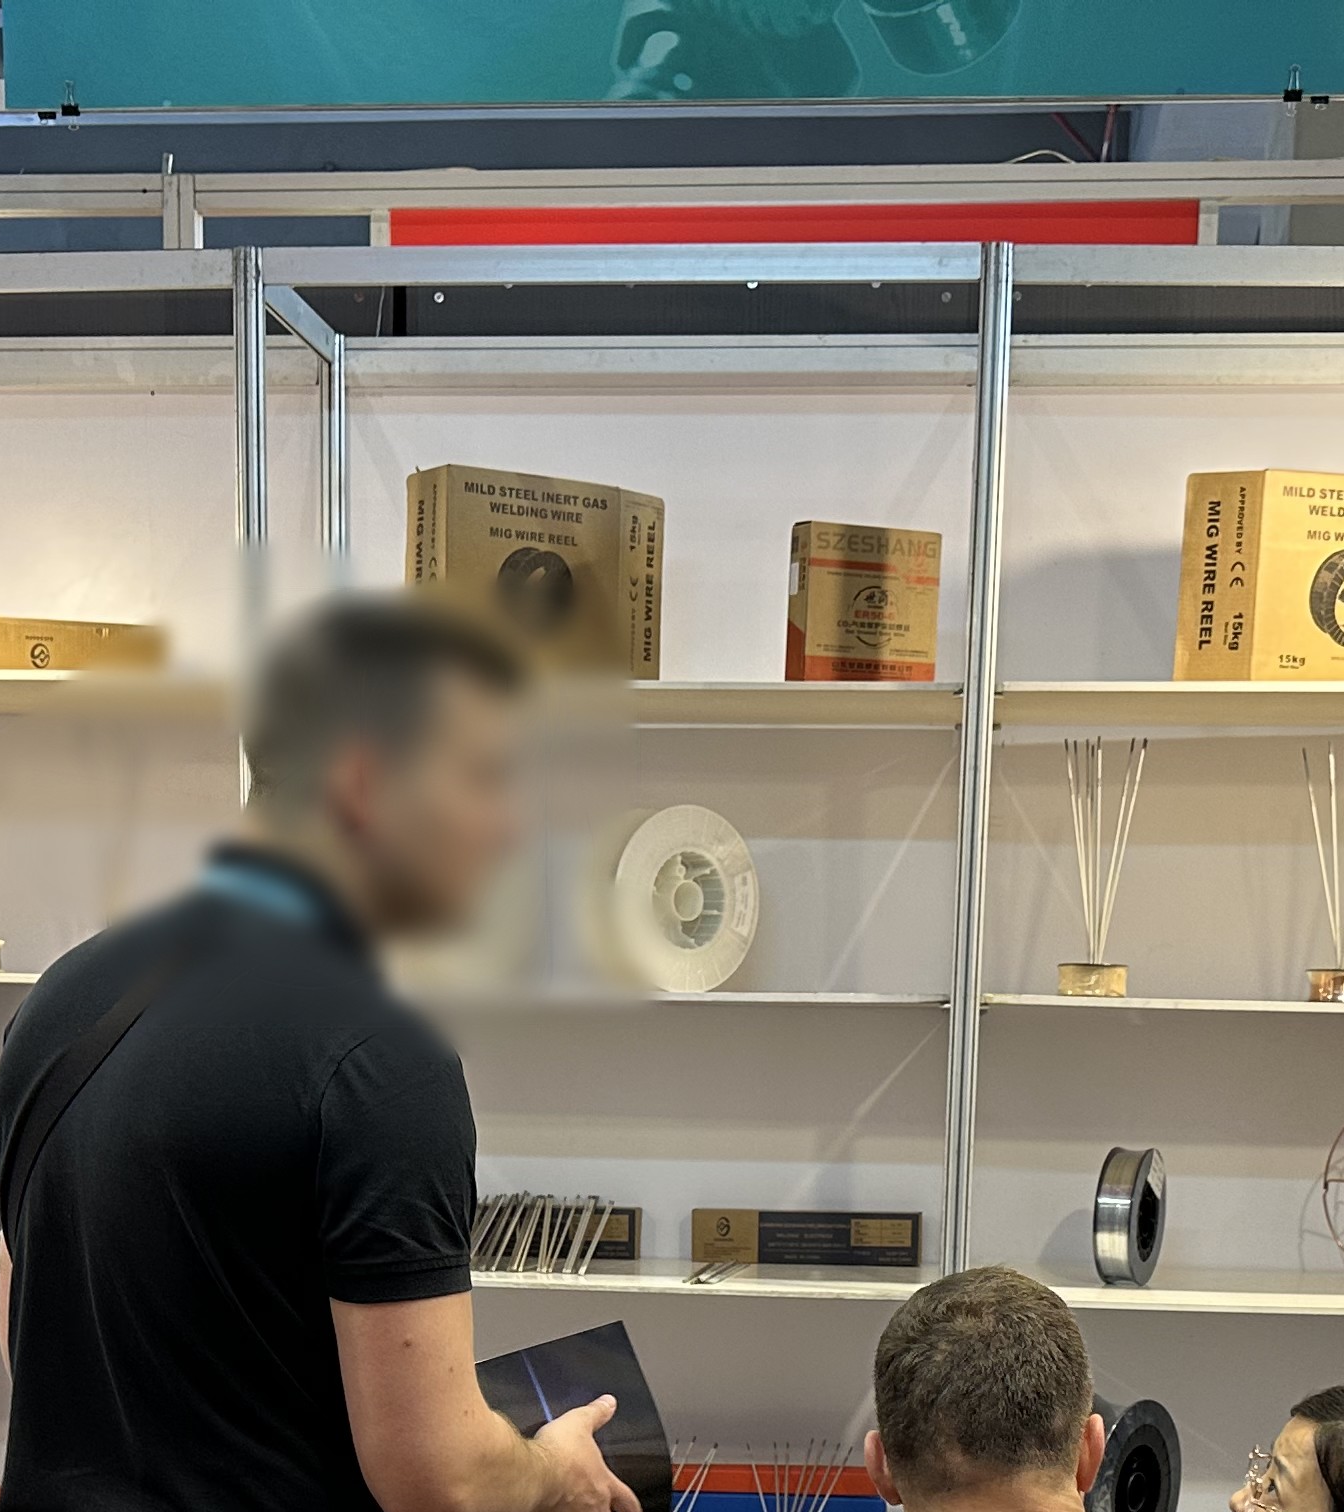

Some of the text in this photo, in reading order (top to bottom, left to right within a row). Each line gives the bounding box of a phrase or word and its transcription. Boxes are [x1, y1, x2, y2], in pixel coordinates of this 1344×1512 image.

[464, 481, 608, 511] MILD STEEL INERT GAS
[1282, 485, 1316, 499] MILD
[489, 501, 583, 525] WELDING WIRE
[1236, 486, 1246, 539] APPROVED
[489, 526, 578, 547] MIG WIRE REEL
[816, 531, 937, 559] SZESHANG
[1306, 529, 1331, 542] MIG
[415, 540, 424, 585] WIR
[1198, 500, 1221, 651] MIG WIRE REEL
[643, 520, 656, 662] MIG WIRE REEL
[1228, 612, 1244, 651] 15kg
[1278, 654, 1306, 667] 15kg
